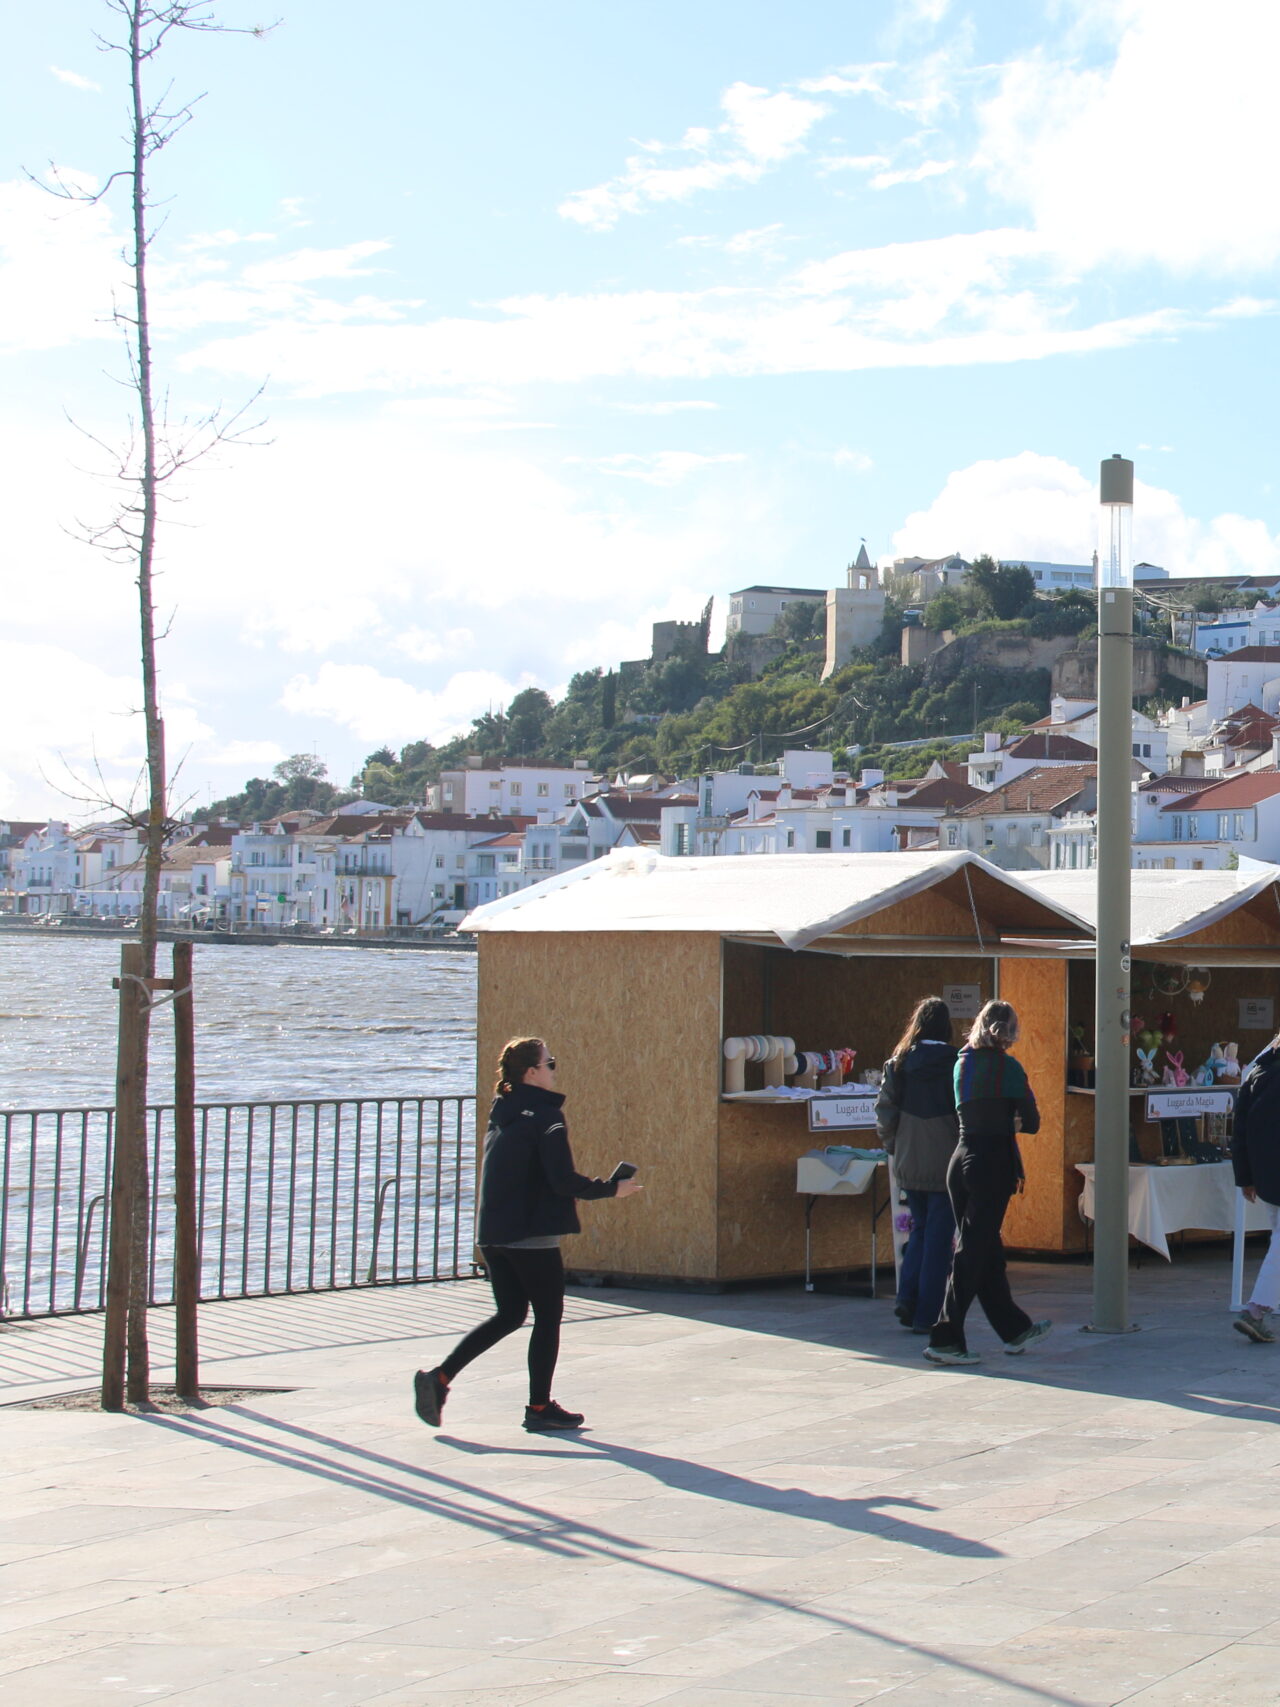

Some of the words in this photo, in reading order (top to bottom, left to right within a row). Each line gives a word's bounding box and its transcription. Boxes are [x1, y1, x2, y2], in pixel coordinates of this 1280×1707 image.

[836, 1103, 859, 1116] Lugar
[860, 1102, 870, 1112] da
[1167, 1097, 1186, 1109] Lugar
[1186, 1096, 1195, 1106] da
[1196, 1095, 1215, 1107] Magia
